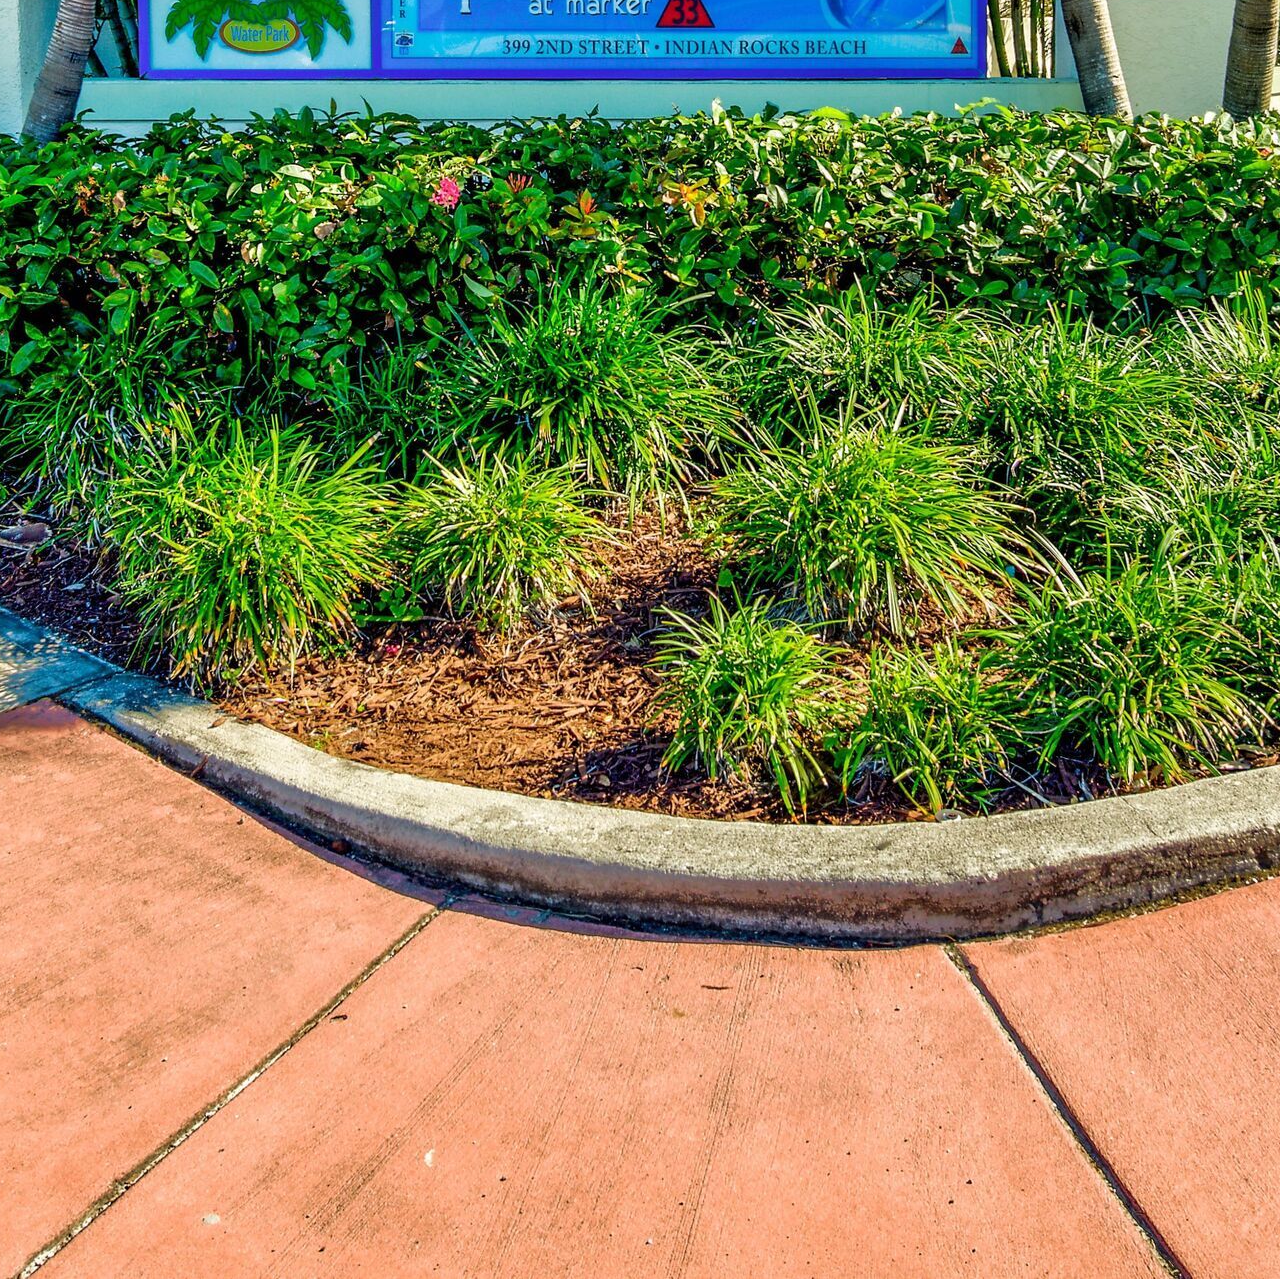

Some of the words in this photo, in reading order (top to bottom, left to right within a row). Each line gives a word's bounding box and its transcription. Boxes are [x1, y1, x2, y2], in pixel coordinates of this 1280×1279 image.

[230, 25, 263, 42] Water
[265, 25, 290, 42] Park
[503, 39, 531, 55] 399
[536, 39, 573, 55] 2ND
[578, 39, 650, 55] STREET
[665, 40, 734, 55] INDIAN
[739, 40, 800, 55] ROCKS
[805, 40, 867, 55] BEACH
